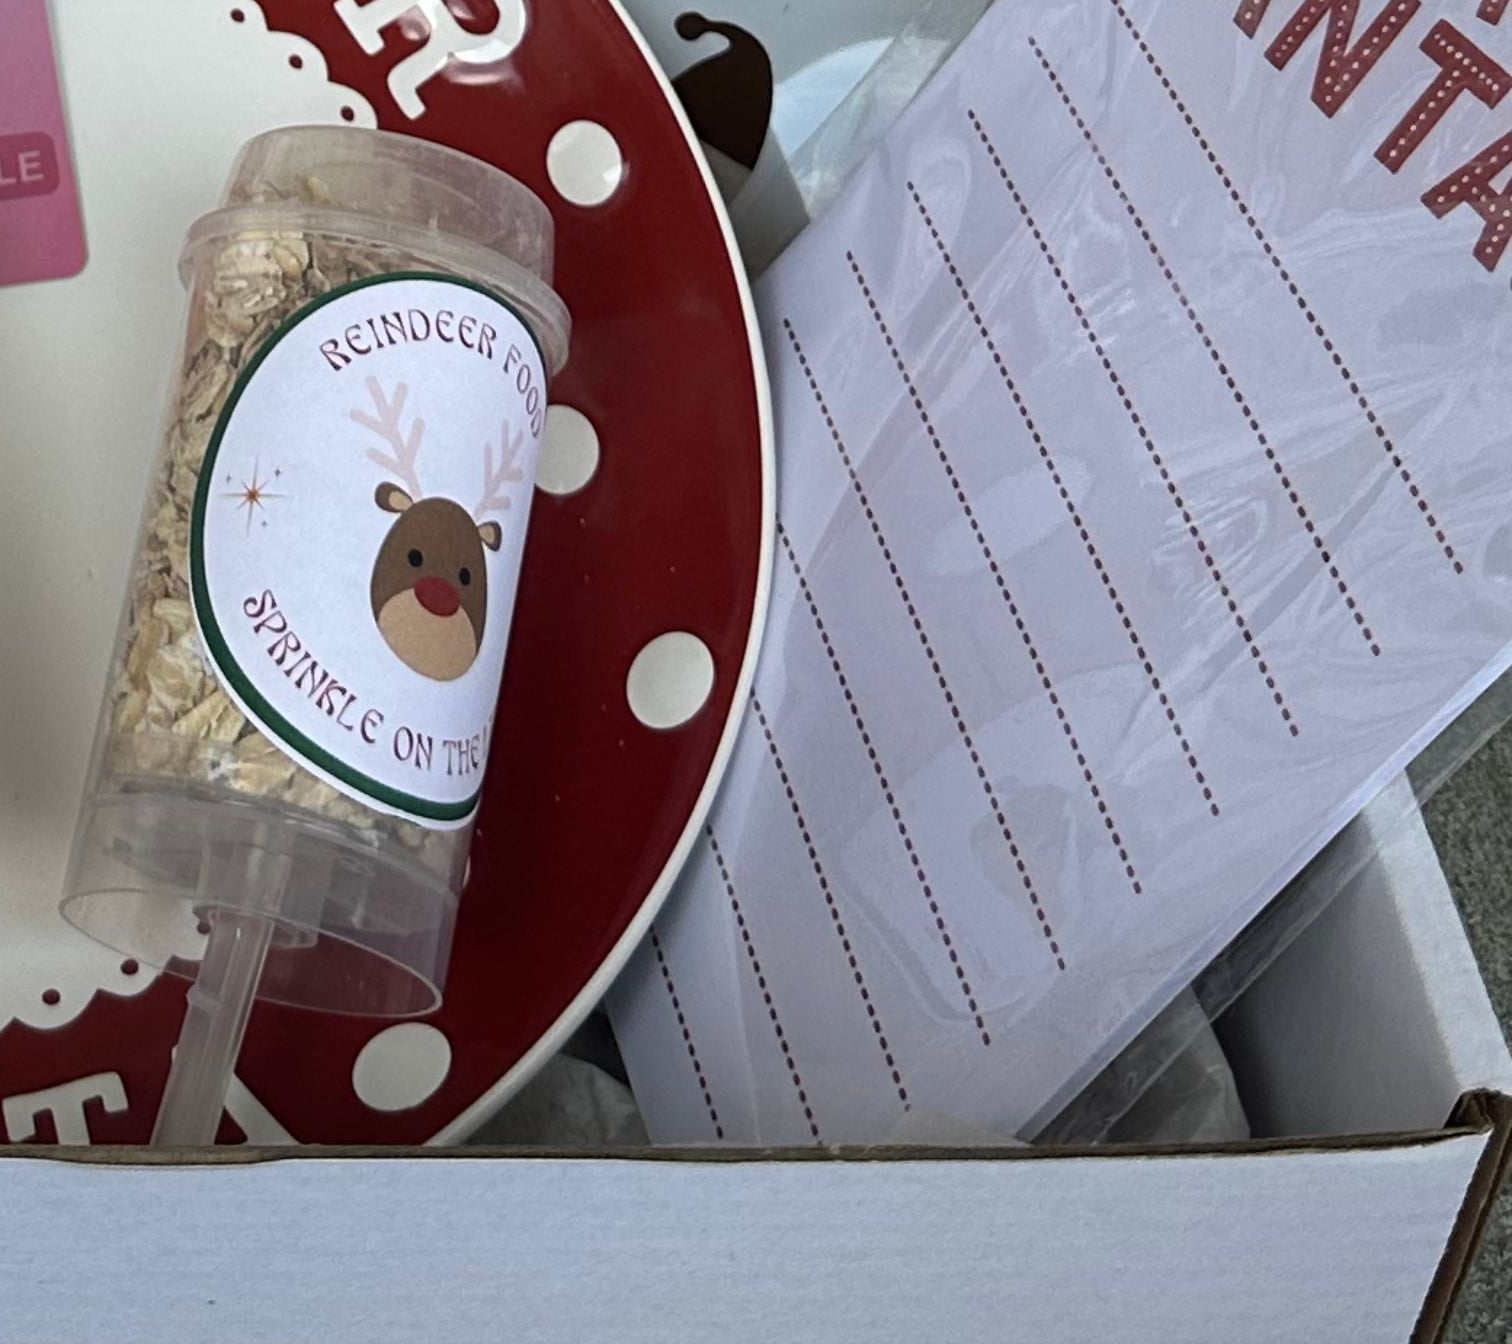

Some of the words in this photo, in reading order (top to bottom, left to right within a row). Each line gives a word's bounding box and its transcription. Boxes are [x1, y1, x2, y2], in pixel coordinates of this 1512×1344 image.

[319, 308, 498, 372] REINDEER
[503, 343, 544, 439] FOOD
[243, 589, 385, 745] SPRINKLE
[392, 725, 434, 771] ON
[442, 733, 481, 776] THE
